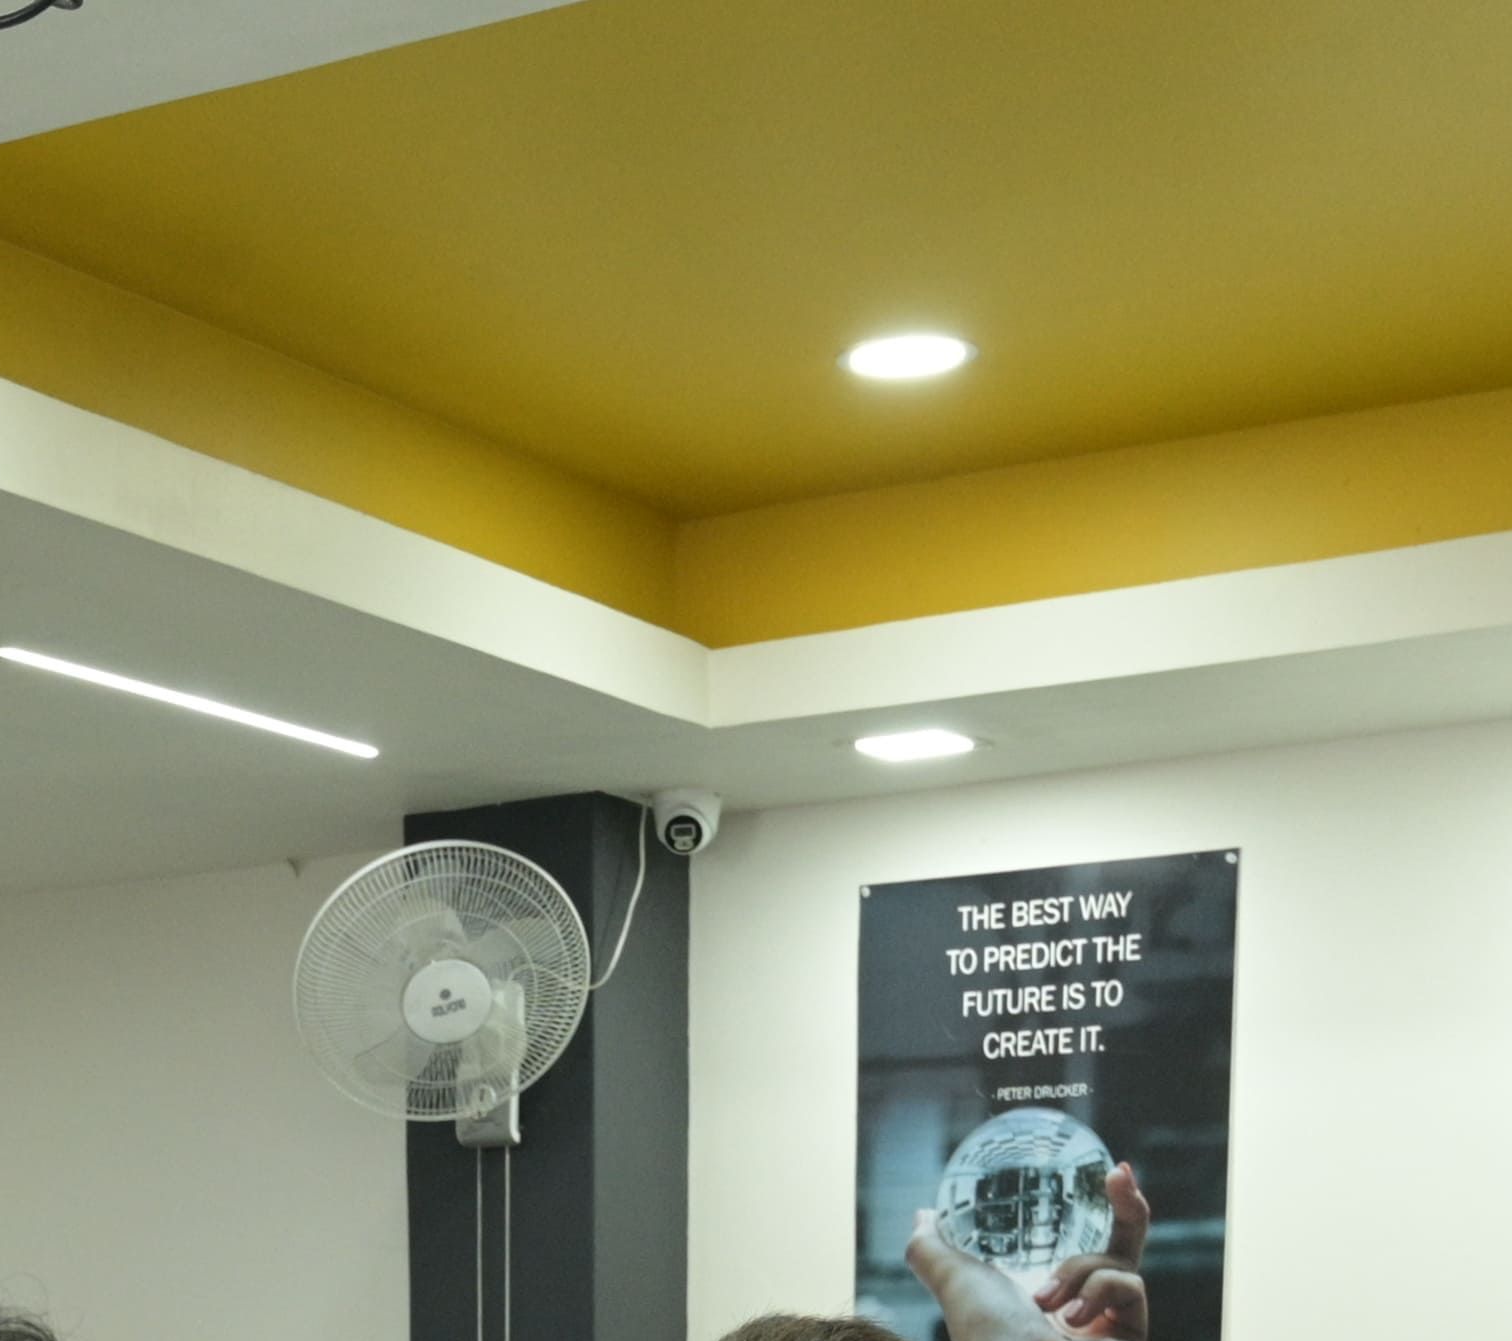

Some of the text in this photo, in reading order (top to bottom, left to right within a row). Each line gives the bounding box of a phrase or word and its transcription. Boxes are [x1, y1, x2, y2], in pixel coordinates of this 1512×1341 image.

[957, 890, 1134, 932] THE BEST WAY
[946, 933, 1143, 976] TO PREDICT THE
[962, 979, 1124, 1018] FUTURE IS TO
[983, 1025, 1106, 1060] CREATE IT.
[997, 1083, 1088, 1101] PETER DRUCKER
